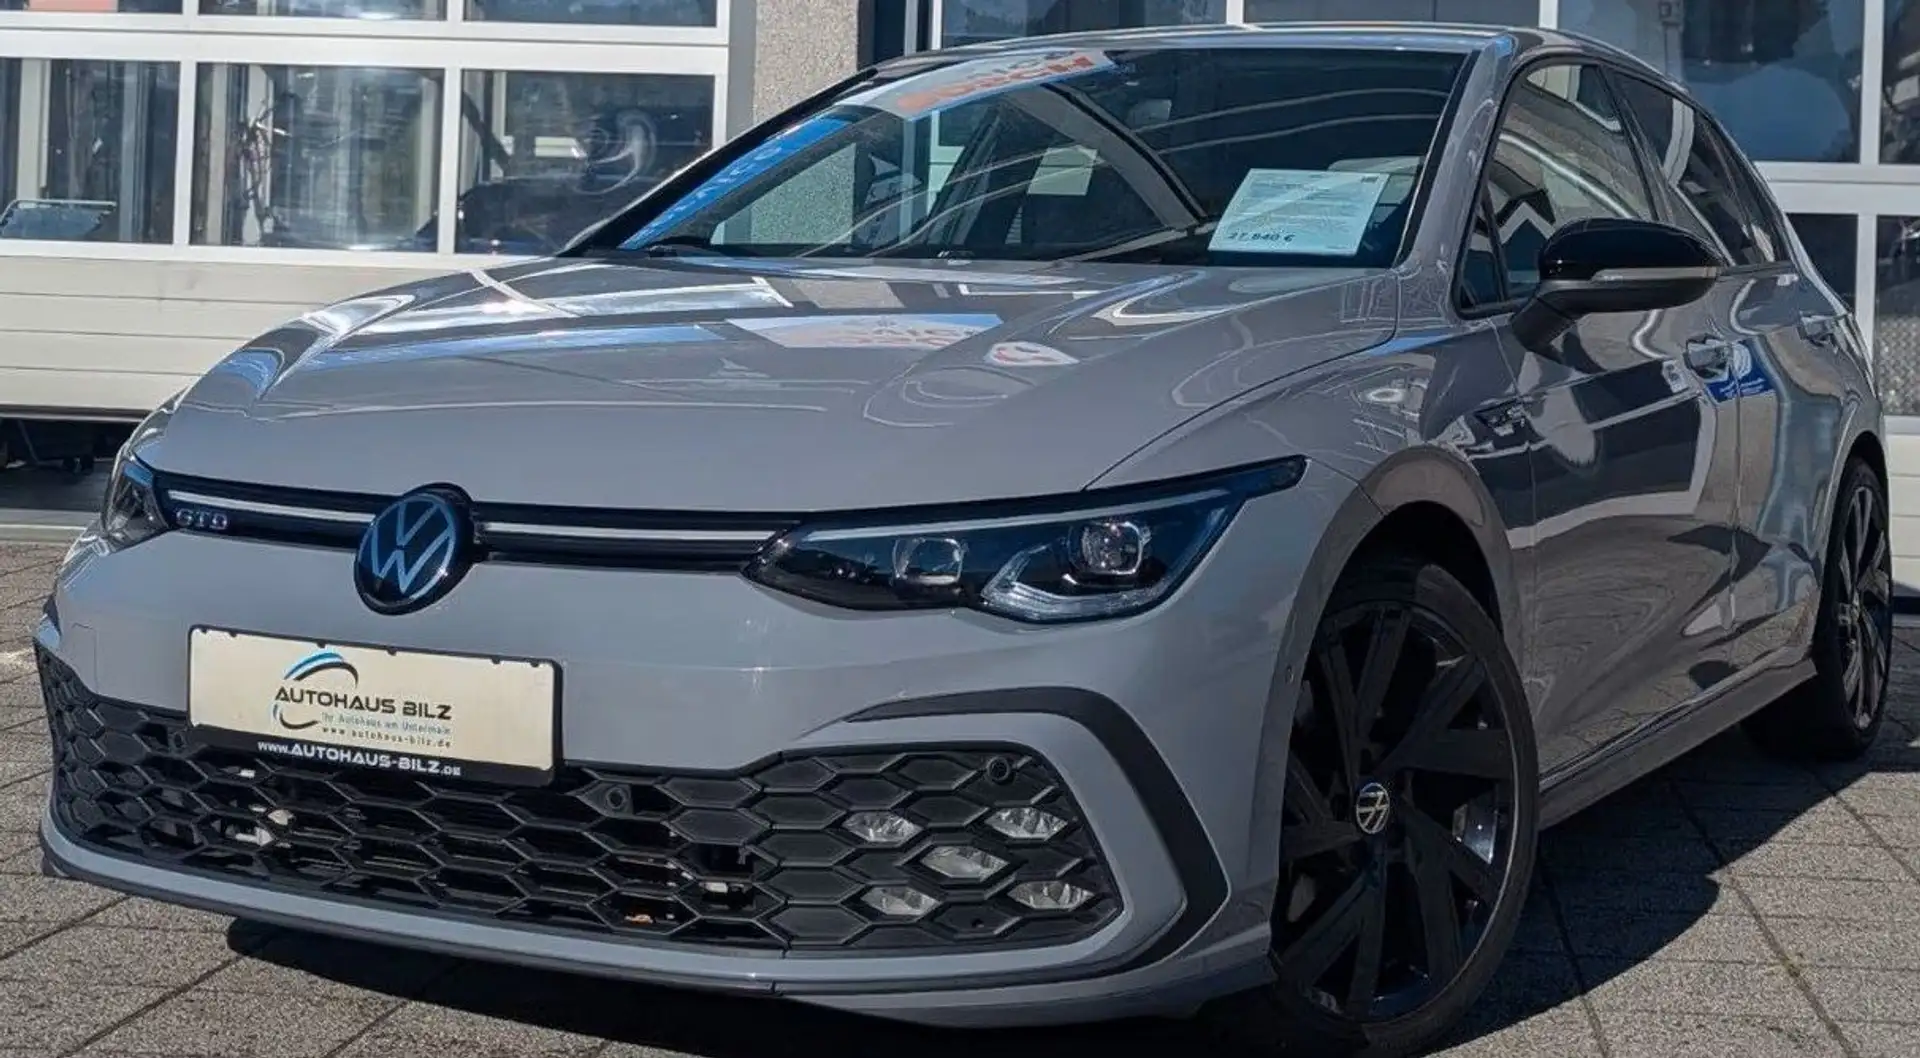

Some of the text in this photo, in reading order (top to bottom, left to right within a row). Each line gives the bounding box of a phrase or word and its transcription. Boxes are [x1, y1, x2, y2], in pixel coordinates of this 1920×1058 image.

[175, 508, 228, 530] GTD
[274, 685, 453, 720] AUTOHAUS BILZ
